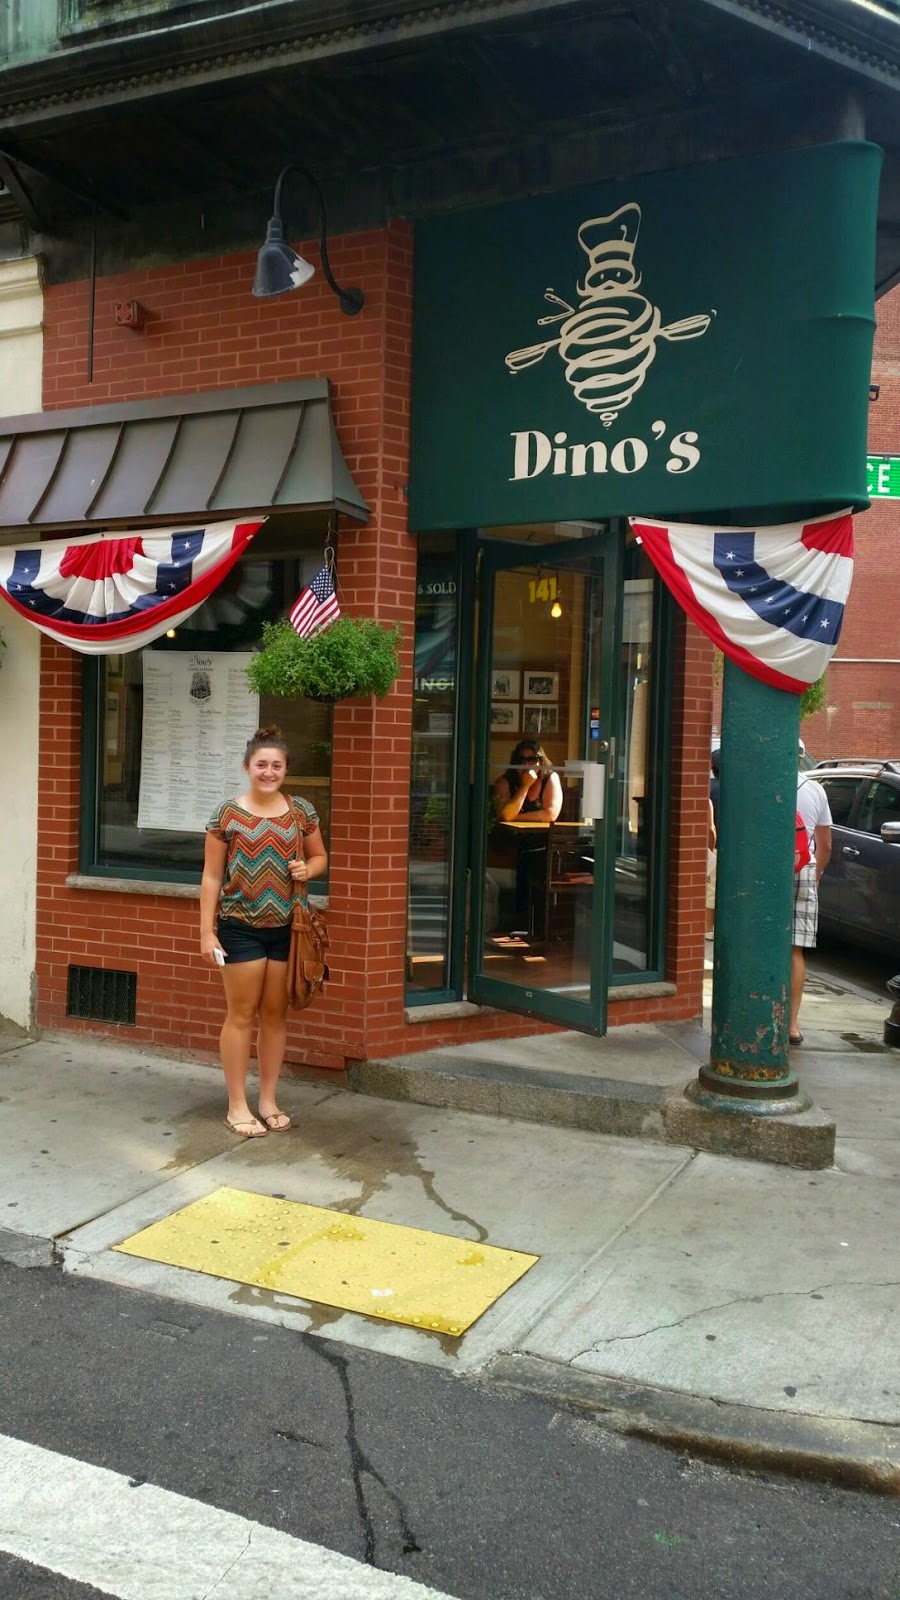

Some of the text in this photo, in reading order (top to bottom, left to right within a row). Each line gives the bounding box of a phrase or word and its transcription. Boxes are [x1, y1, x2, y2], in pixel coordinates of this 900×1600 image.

[508, 420, 701, 481] Dino's
[425, 581, 457, 595] SOLD
[528, 577, 557, 603] 141
